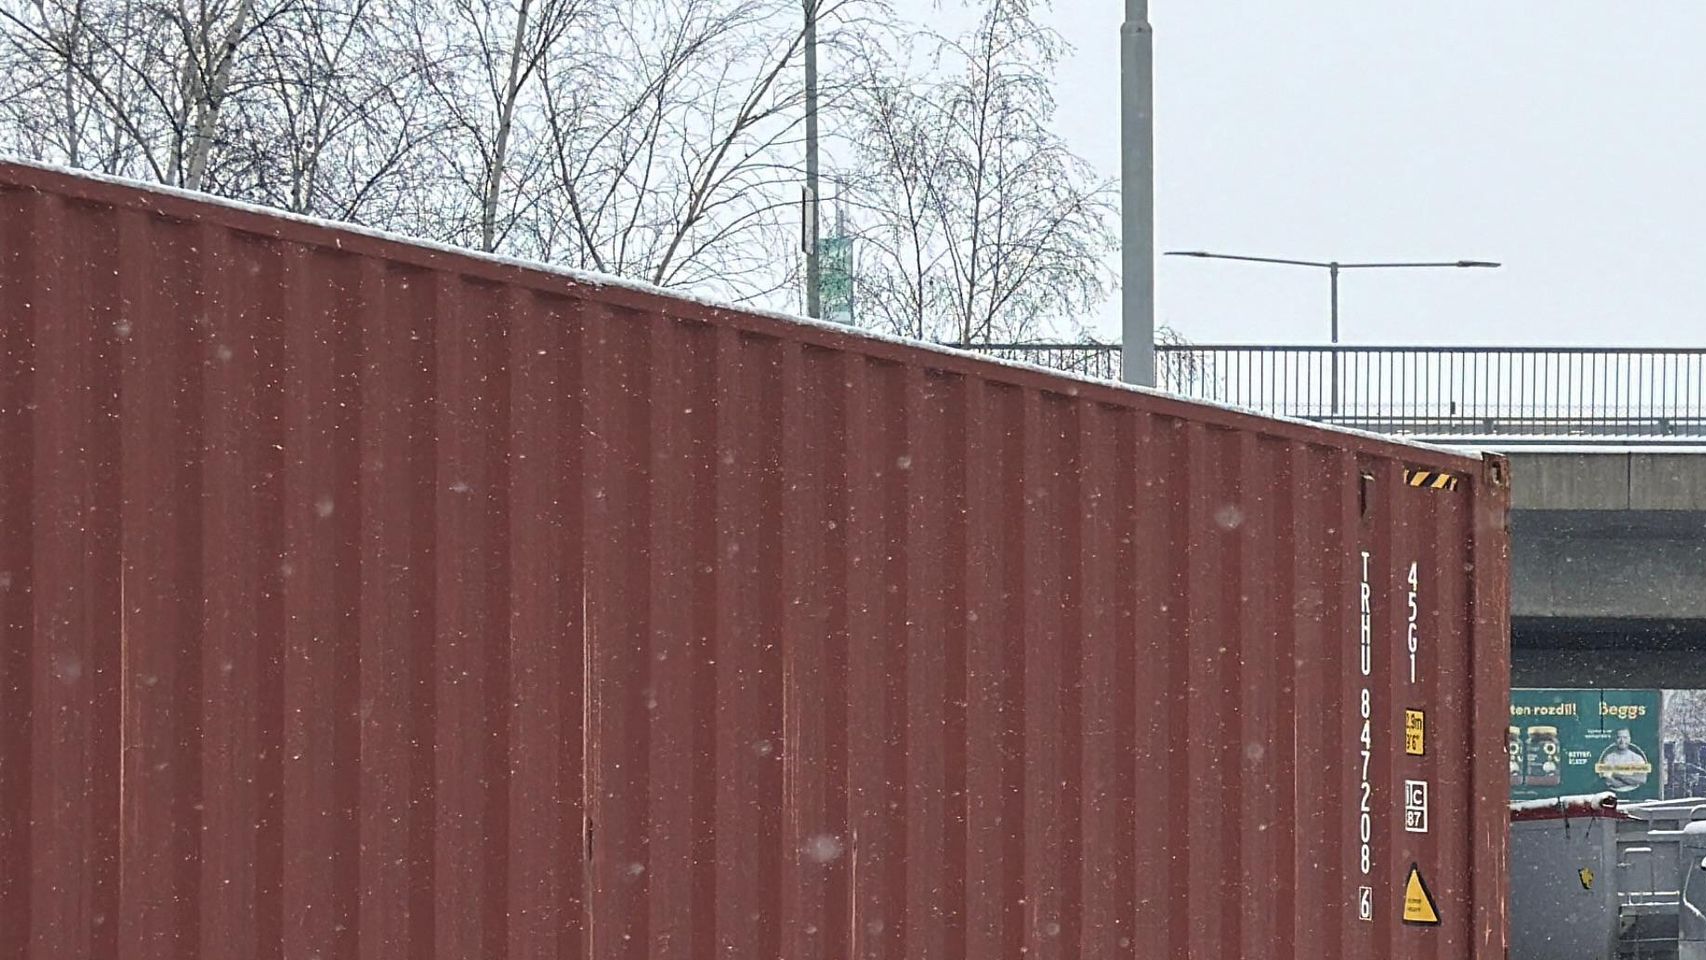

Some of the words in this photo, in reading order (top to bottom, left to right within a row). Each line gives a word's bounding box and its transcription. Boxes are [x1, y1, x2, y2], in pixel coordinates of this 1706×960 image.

[1360, 551, 1371, 676] TRHU
[1407, 561, 1418, 684] 45G1
[1598, 701, 1646, 719] Beggs
[1360, 688, 1371, 874] 847208
[1407, 810, 1422, 827] 87
[1361, 889, 1370, 918] 6
